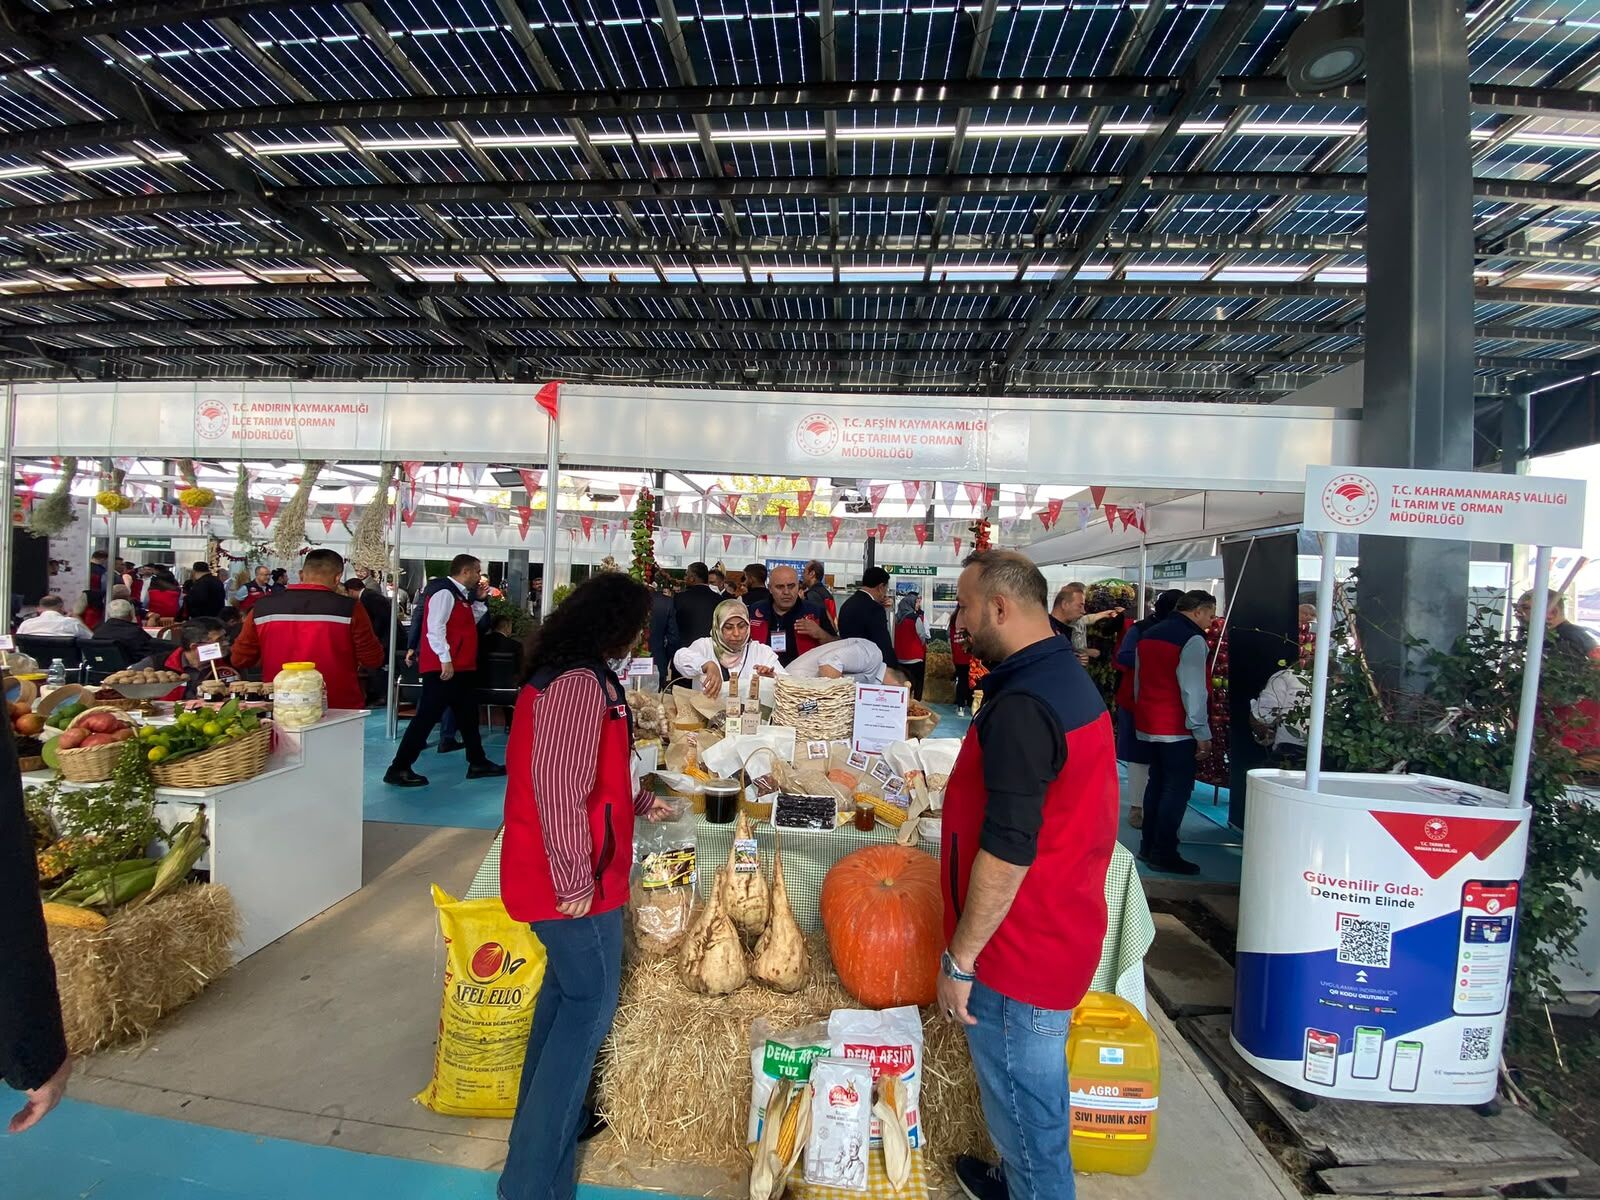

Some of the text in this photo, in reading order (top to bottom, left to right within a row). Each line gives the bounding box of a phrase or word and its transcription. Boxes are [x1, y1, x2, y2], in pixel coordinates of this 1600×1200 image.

[232, 403, 369, 414] T.C. ANDIRIN KAYMAKAMLIĞI
[232, 416, 335, 427] İLÇE TARIM VE ORMAN
[843, 416, 987, 432] T.C. AFŞİN KAYMAKAMLIĞI
[232, 429, 294, 440] MÜDÜRLÜĞÜ
[842, 430, 963, 446] İLÇE TARIM VE ORMAN
[842, 446, 913, 459] MÜDÜRLÜĞÜ
[1392, 485, 1568, 505] T.C. KAHRAMANMARAŞ VALİLİĞİ
[1391, 497, 1503, 514] İL TARIM VE ORMAN
[1389, 511, 1465, 526] MÜDÜRLÜĞÜ
[1303, 871, 1424, 897] Güvenilir Gıda:
[1311, 886, 1415, 909] Denetim Elinde
[488, 988, 522, 1006] ELLO
[766, 1044, 796, 1063] DEHA
[879, 1047, 912, 1067] AFŞİN
[778, 1065, 799, 1077] TUZ
[1089, 1085, 1120, 1097] AGRO
[1075, 1111, 1147, 1125] SIVI HUMİK ASİT
